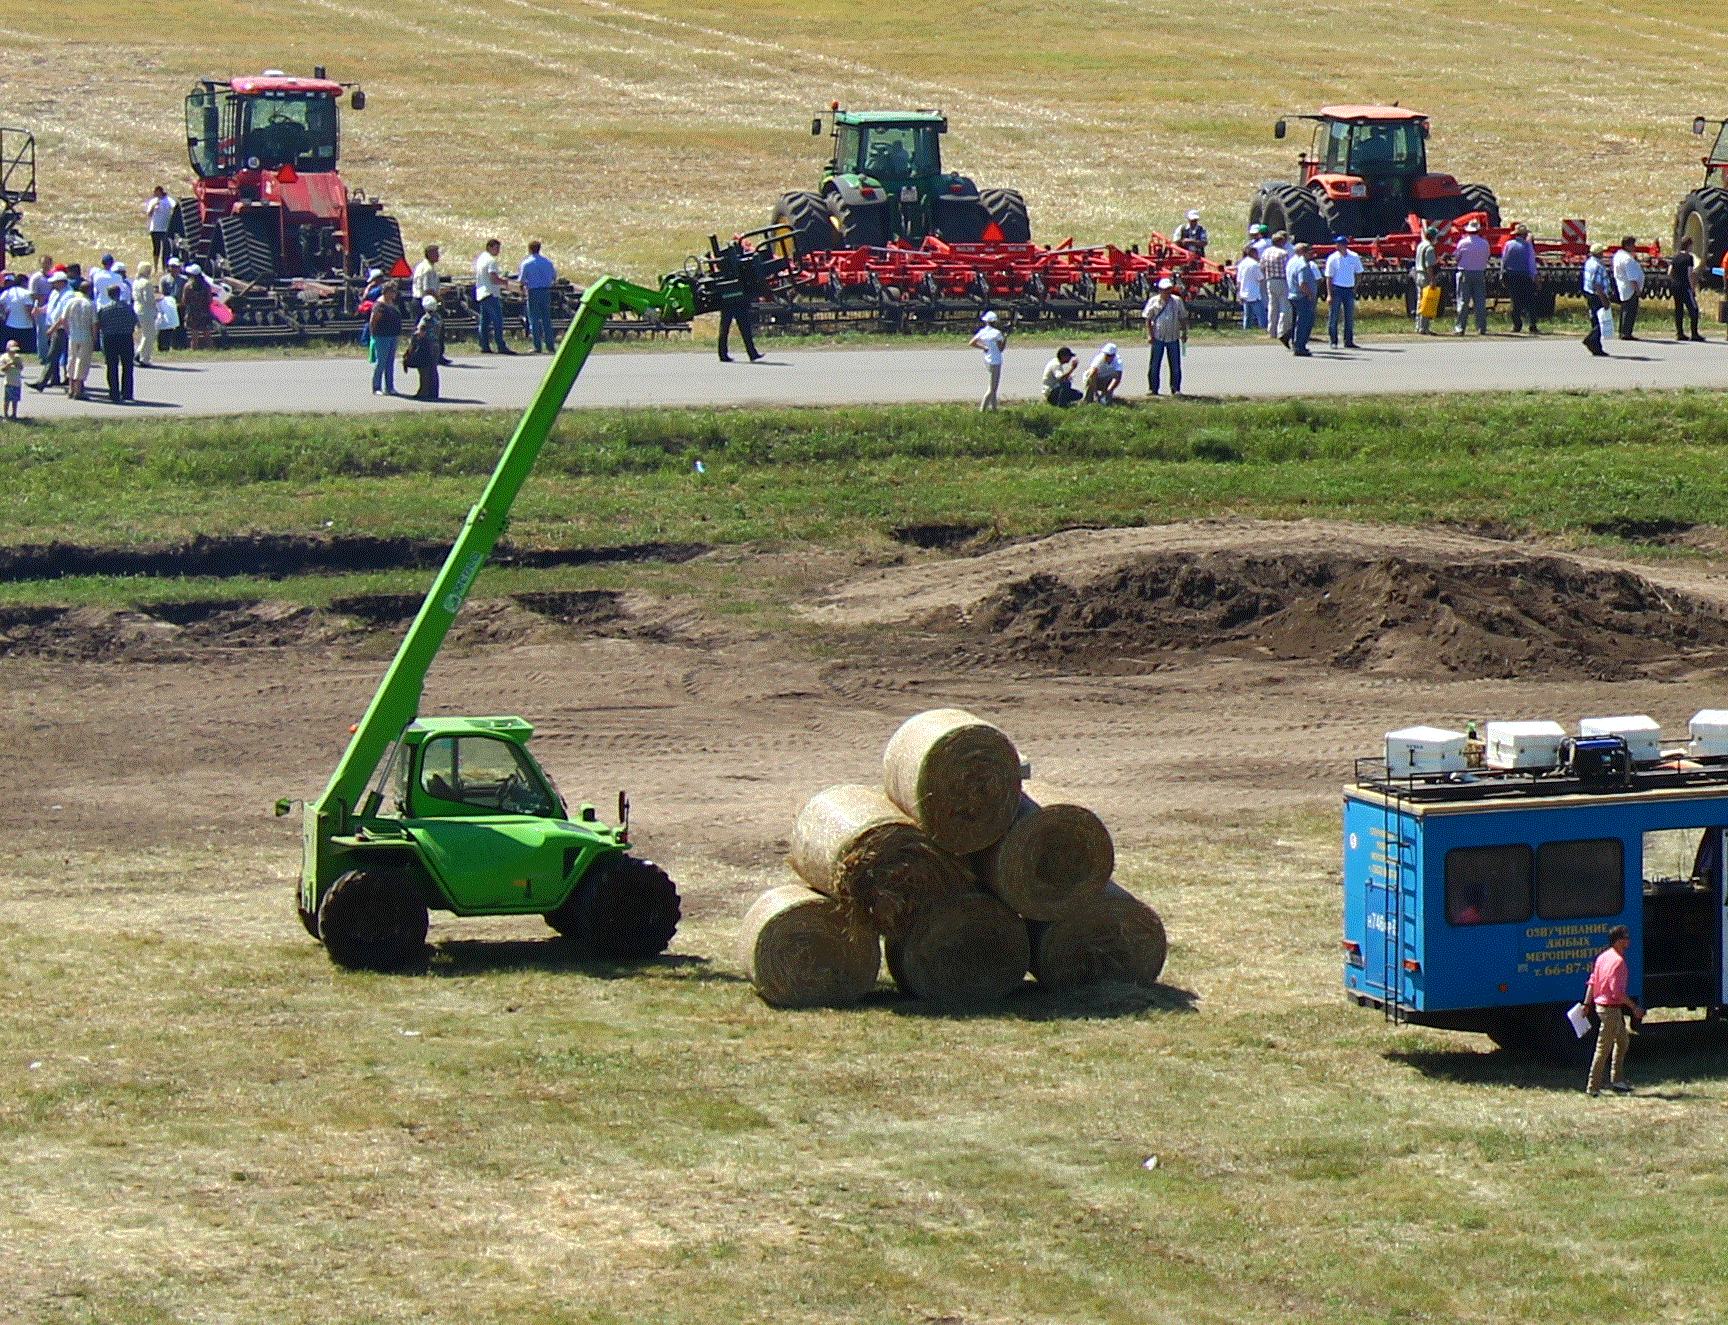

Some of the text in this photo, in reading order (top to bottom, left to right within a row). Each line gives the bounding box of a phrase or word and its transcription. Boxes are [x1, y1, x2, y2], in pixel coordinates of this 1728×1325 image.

[1525, 923, 1609, 938] ОЗВУЧИВАНИЕ
[1545, 936, 1590, 949] ЛЮБЫХ
[1525, 946, 1606, 962] МЕРОПРИЯТИ
